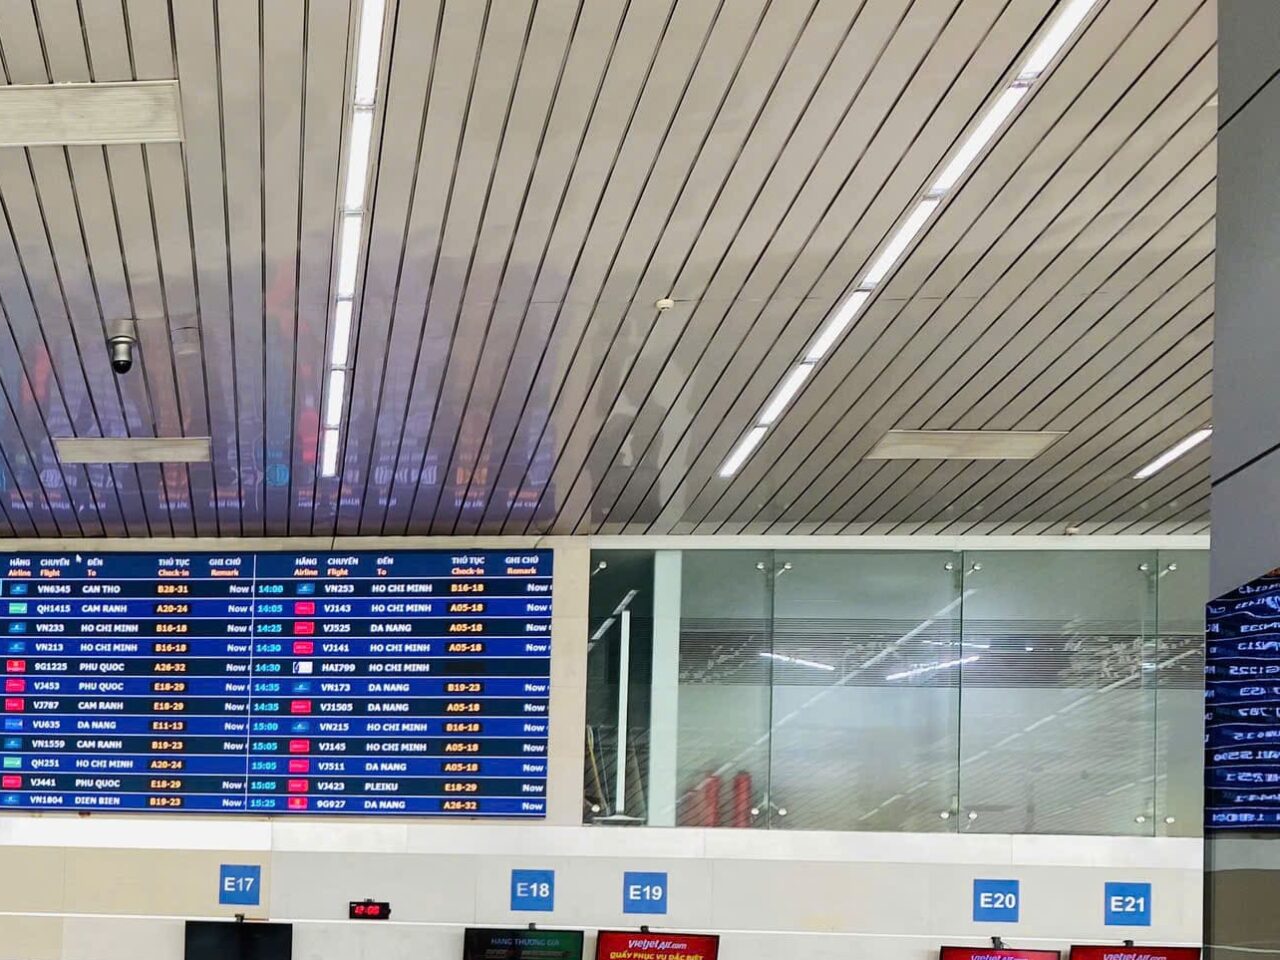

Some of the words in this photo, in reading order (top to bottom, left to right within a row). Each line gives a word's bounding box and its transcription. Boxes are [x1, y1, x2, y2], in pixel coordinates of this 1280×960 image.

[81, 584, 101, 595] CAN
[101, 584, 121, 595] THO
[371, 583, 387, 594] HO
[387, 583, 406, 594] CHI
[406, 583, 433, 593] MINH
[81, 604, 101, 614] CAM
[102, 604, 128, 614] RANH
[80, 623, 95, 633] HO
[95, 623, 113, 633] CHI
[113, 623, 139, 633] MINH
[369, 623, 384, 633] DA
[384, 623, 412, 633] NANG
[368, 663, 384, 673] HO
[384, 663, 403, 673] CHI
[403, 663, 430, 673] MINH
[77, 700, 98, 711] CAM
[98, 701, 124, 711] RANH
[76, 720, 91, 730] DA
[91, 720, 117, 730] NANG
[76, 739, 96, 750] CAM
[96, 740, 123, 750] RANH
[364, 782, 399, 792] PLEIKU
[521, 783, 544, 793] Now
[74, 795, 98, 806] DIEN
[98, 796, 121, 806] BIEN
[224, 877, 255, 892] E17
[517, 882, 550, 898] E18
[629, 885, 663, 901] E19
[980, 893, 1016, 909] E20
[1110, 896, 1145, 913] E21
